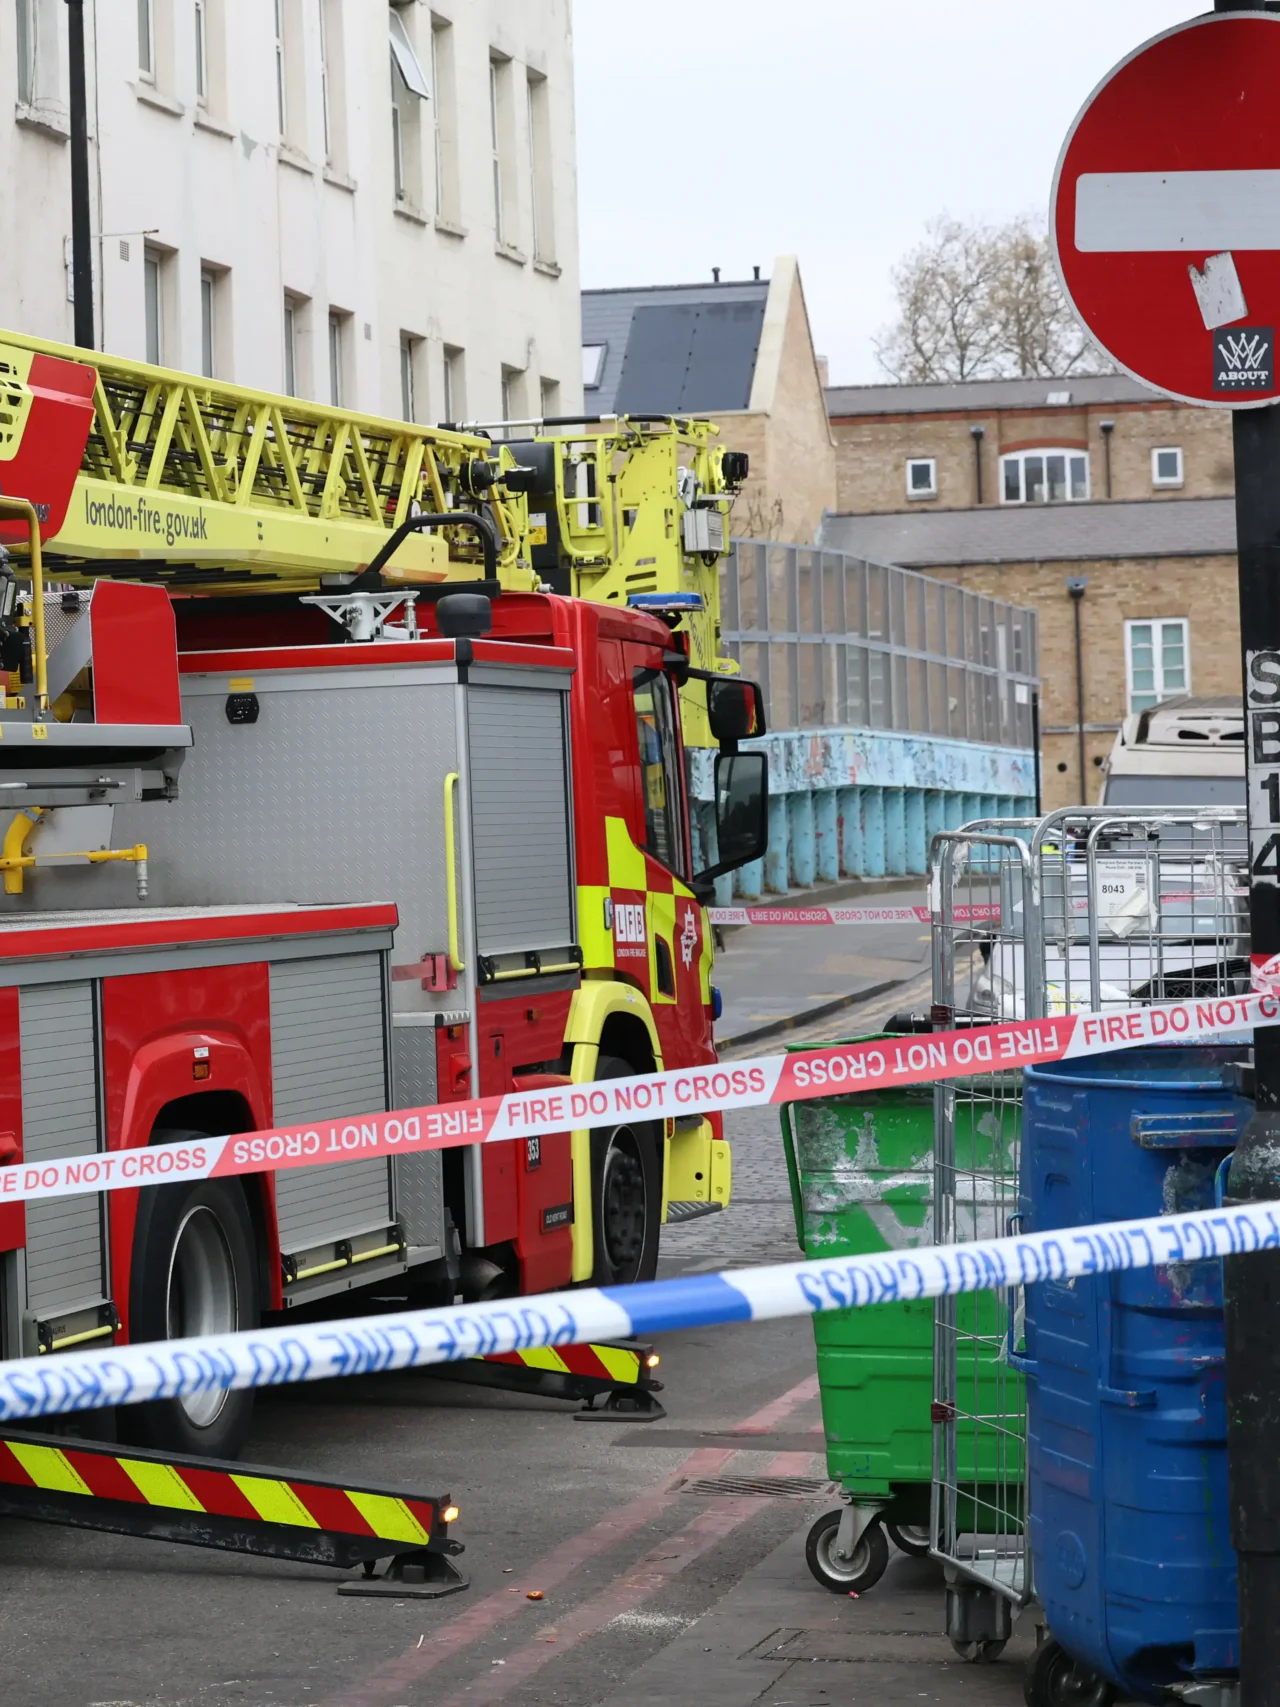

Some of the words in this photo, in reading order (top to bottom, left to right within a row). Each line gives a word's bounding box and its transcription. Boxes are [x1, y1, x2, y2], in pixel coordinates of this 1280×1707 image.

[1218, 371, 1268, 380] ABOUT
[85, 489, 208, 546] london-fire.gov.uk
[1102, 885, 1125, 894] 8043
[998, 1025, 1059, 1059] FIRE
[1083, 1013, 1145, 1046] FIRE
[1150, 1007, 1190, 1036] DO
[1196, 998, 1251, 1029] NOT
[793, 1051, 886, 1087] CROSS
[892, 1042, 948, 1073] NOT
[953, 1035, 993, 1065] DO
[507, 1096, 565, 1126] FIRE
[571, 1090, 609, 1118] DO
[614, 1081, 667, 1112] NOT
[674, 1067, 766, 1103] CROSS
[325, 1122, 379, 1153] NOT
[384, 1116, 421, 1144] DO
[426, 1107, 484, 1138] FIRE
[24, 1168, 59, 1190] DO
[65, 1159, 116, 1185] NOT
[121, 1147, 207, 1178] CROSS
[233, 1131, 321, 1164] CROSS
[528, 1138, 539, 1161] 353
[1072, 1227, 1156, 1273] LINE
[1159, 1210, 1280, 1261] POLICE
[934, 1248, 1009, 1295] NOT
[1017, 1240, 1068, 1281] DO
[796, 1259, 925, 1310] CROSS
[318, 1323, 420, 1376] LINE
[424, 1305, 577, 1360] POLICE
[147, 1347, 238, 1397] NOT
[247, 1337, 311, 1386] DO
